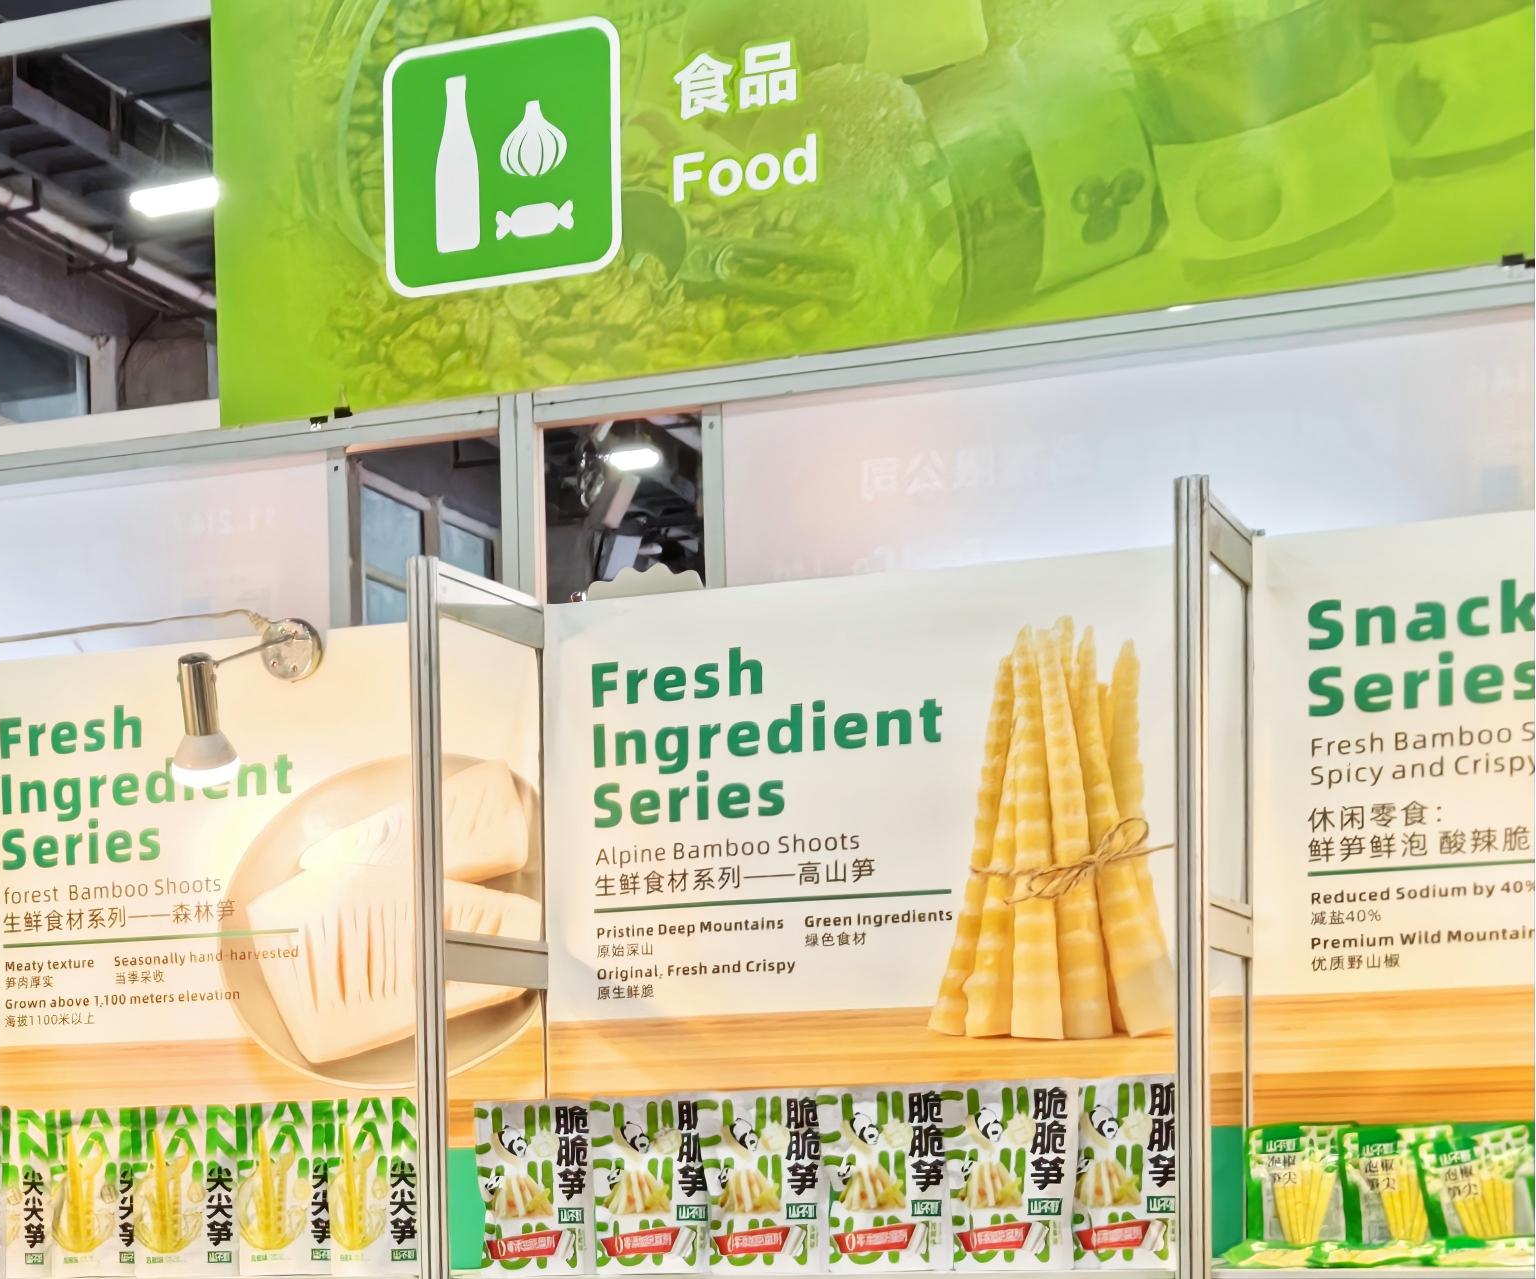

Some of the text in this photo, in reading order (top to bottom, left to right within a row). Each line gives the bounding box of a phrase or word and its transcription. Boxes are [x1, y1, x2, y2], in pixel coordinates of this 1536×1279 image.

[673, 40, 798, 121] 食品
[673, 133, 817, 203] Food
[592, 646, 763, 708] Fresh
[0, 705, 142, 759] Fresh
[593, 698, 943, 775] Ingredient
[1311, 725, 1512, 758] Fresh Bamboo
[1310, 762, 1384, 790] Spicy
[1392, 755, 1444, 780] and
[593, 769, 786, 829] Series
[1, 818, 161, 870] Series
[595, 833, 860, 868] Alpine Bamboo Shoots
[1308, 831, 1428, 863] 鲜笋鲜泡
[4, 876, 221, 905] forest Bamboo Shoots
[1311, 887, 1390, 905] Reduced
[1396, 884, 1467, 900] Sodium
[1473, 882, 1495, 899] by
[597, 917, 784, 940] Pristine Deep Mountains
[804, 908, 953, 928] Green Ingredients
[114, 945, 299, 968] Seasonally hand-harvested
[597, 942, 654, 959] 原始深山
[804, 931, 867, 948] 绿色食材
[1311, 933, 1394, 950] Premium
[1400, 930, 1441, 946] Wild
[5, 957, 95, 974] Meaty texture
[5, 974, 54, 989] 笋肉厚实
[597, 958, 796, 981] Original, Fresh and Crispy
[5, 996, 46, 1010] Grown
[50, 994, 90, 1008] above
[129, 992, 175, 1004] meters
[178, 989, 240, 1002] elevation
[597, 984, 655, 1001] 原生鲜脆
[4, 1012, 95, 1028] 海拔1100米以上
[555, 1105, 589, 1201] 脆脆笋
[786, 1096, 820, 1197] 脆脆笋
[908, 1090, 944, 1192] 脆脆笋
[1030, 1086, 1067, 1190] 脆脆笋
[23, 1170, 45, 1249] 尖尖笋
[207, 1166, 233, 1247] 尖尖笋
[390, 1161, 417, 1245] 尖尖笋
